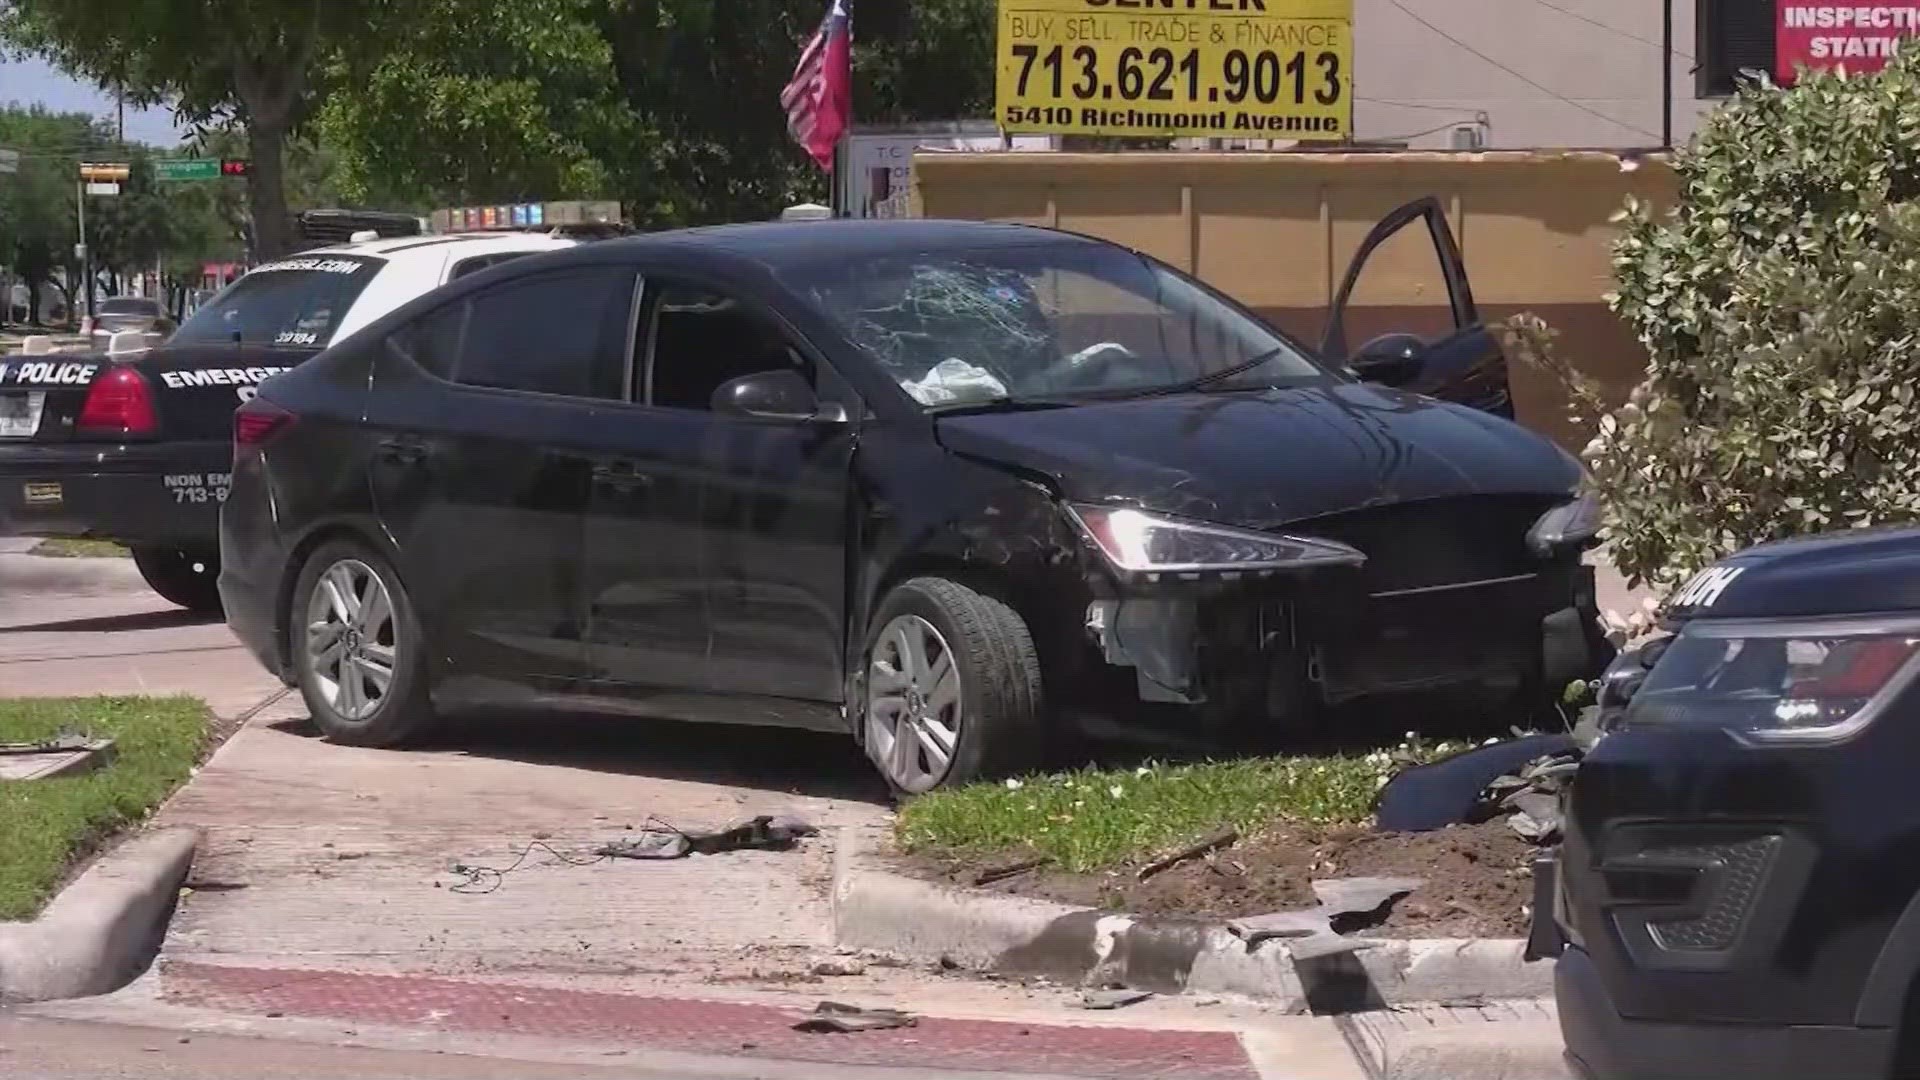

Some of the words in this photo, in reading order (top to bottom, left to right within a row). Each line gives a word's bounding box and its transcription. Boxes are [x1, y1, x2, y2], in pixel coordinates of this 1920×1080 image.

[1785, 7, 1920, 28] INSPECTI
[1128, 19, 1200, 42] TRADE
[1209, 23, 1225, 44] &
[1235, 23, 1337, 46] FINANCE
[1012, 44, 1340, 105] 713.621.9013
[1006, 106, 1072, 125] 5410
[1081, 108, 1226, 129] Richmond
[1233, 112, 1339, 132] Avenue
[17, 363, 98, 384] POLICE
[160, 366, 293, 388] EMERG
[164, 474, 203, 487] NON
